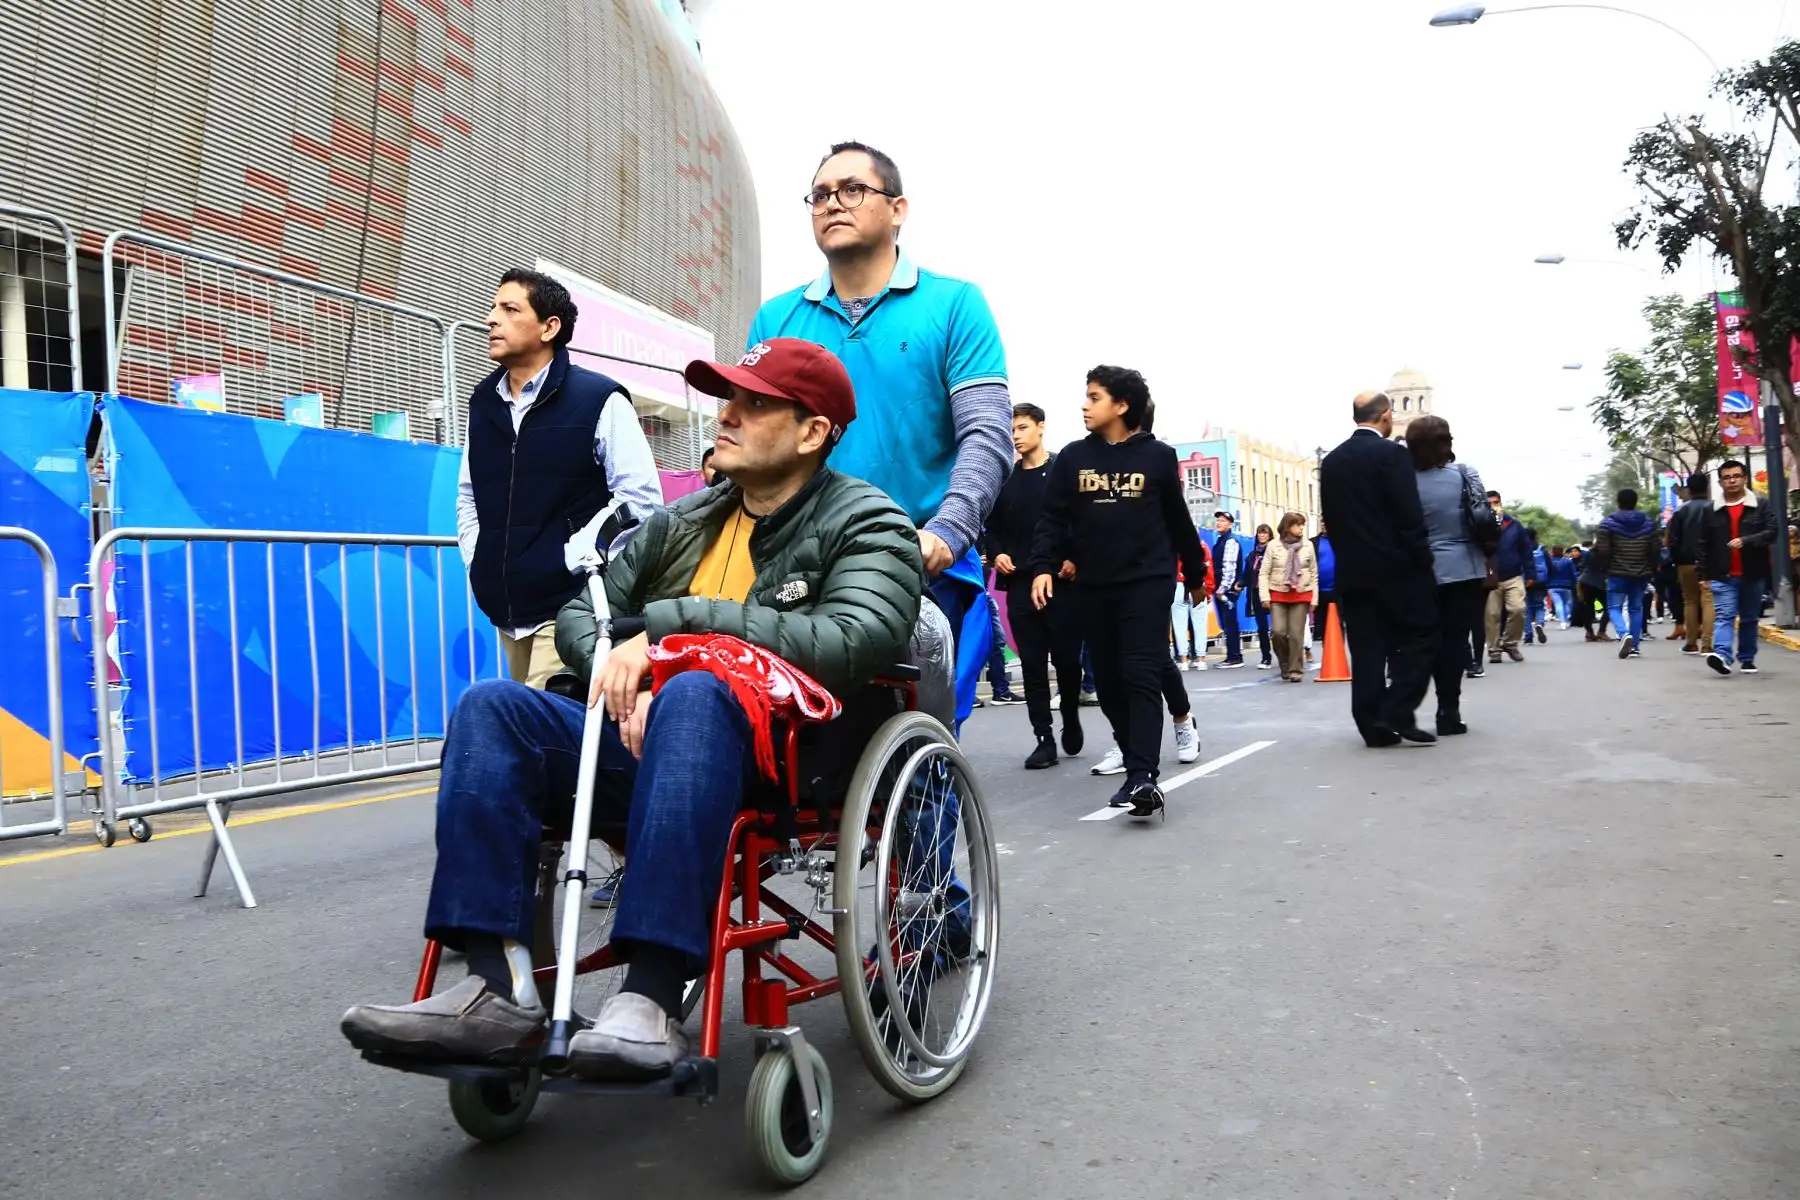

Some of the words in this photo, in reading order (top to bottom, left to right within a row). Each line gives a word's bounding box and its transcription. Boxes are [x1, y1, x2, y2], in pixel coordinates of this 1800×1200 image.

[783, 581, 797, 591] THE
[776, 586, 798, 600] NORTH
[782, 592, 801, 604] FACE
